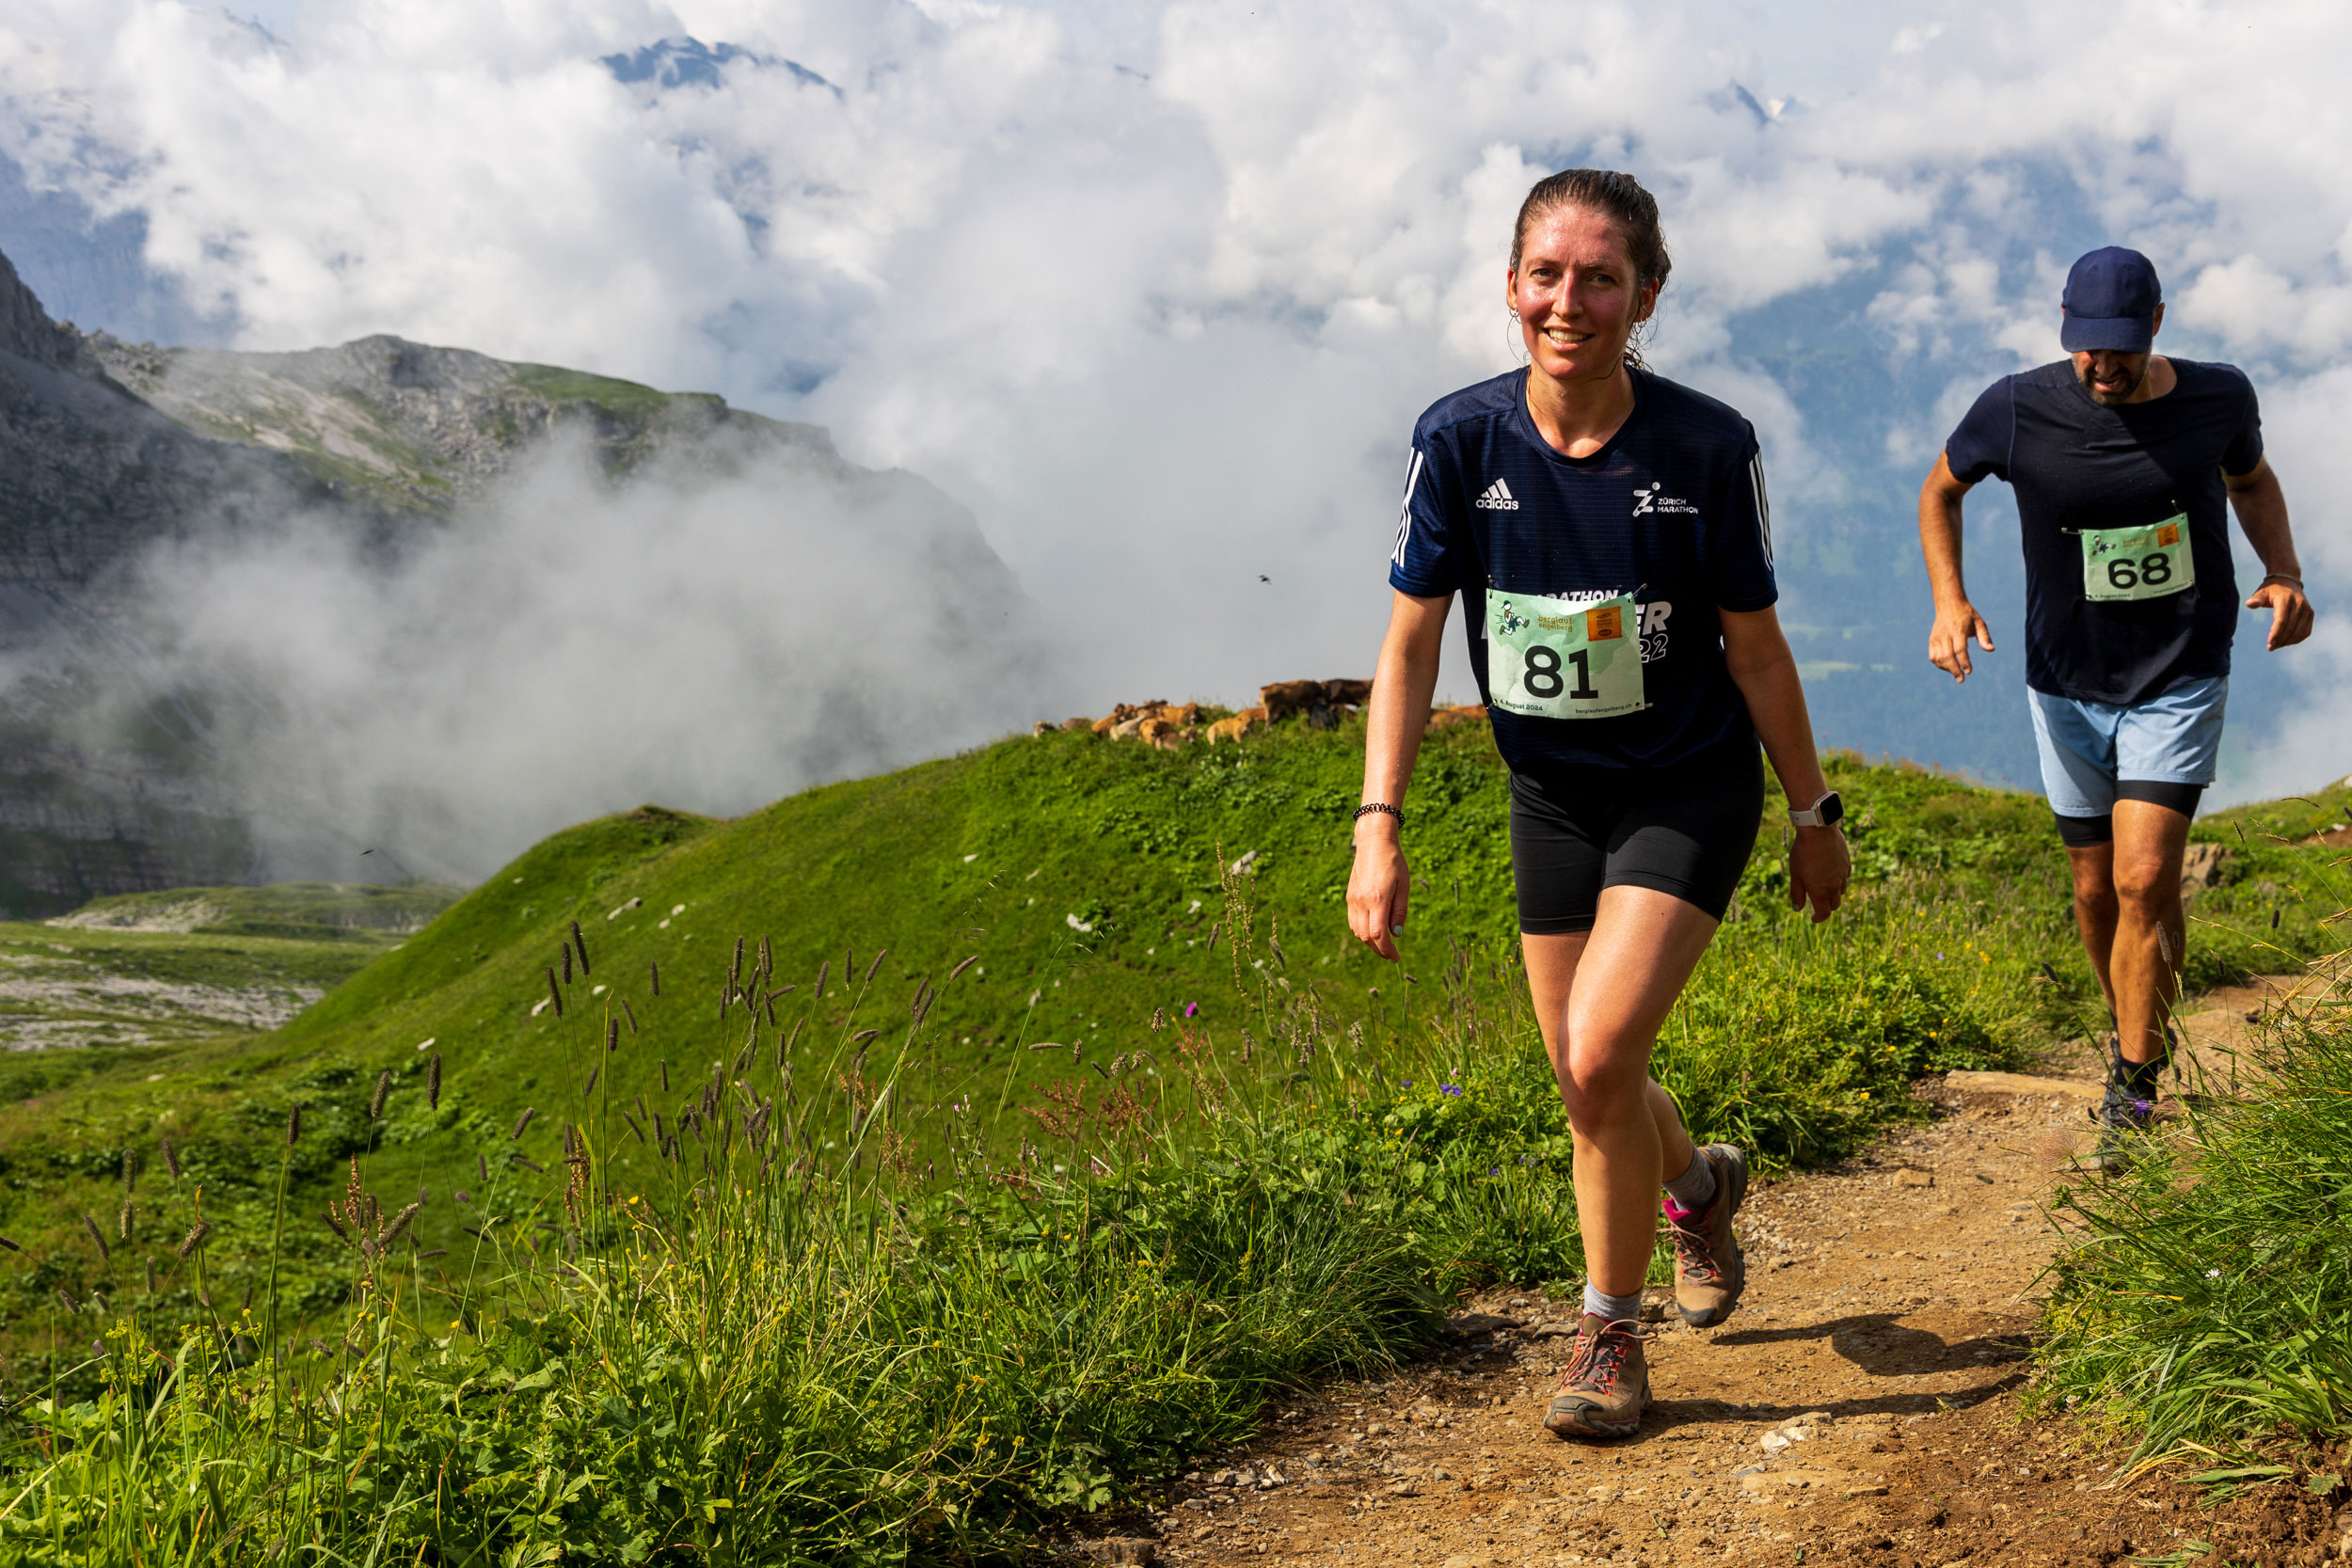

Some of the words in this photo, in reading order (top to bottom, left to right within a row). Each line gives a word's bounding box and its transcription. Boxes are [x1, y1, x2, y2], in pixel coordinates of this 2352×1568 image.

[1475, 497, 1519, 510] adidas
[1658, 497, 1687, 505] ZÜRICH
[1657, 506, 1698, 515] MARATHON
[2107, 552, 2171, 590] 68
[1538, 614, 1573, 625] berglauf
[1538, 624, 1573, 632] engelberg
[1524, 645, 1598, 699] 81
